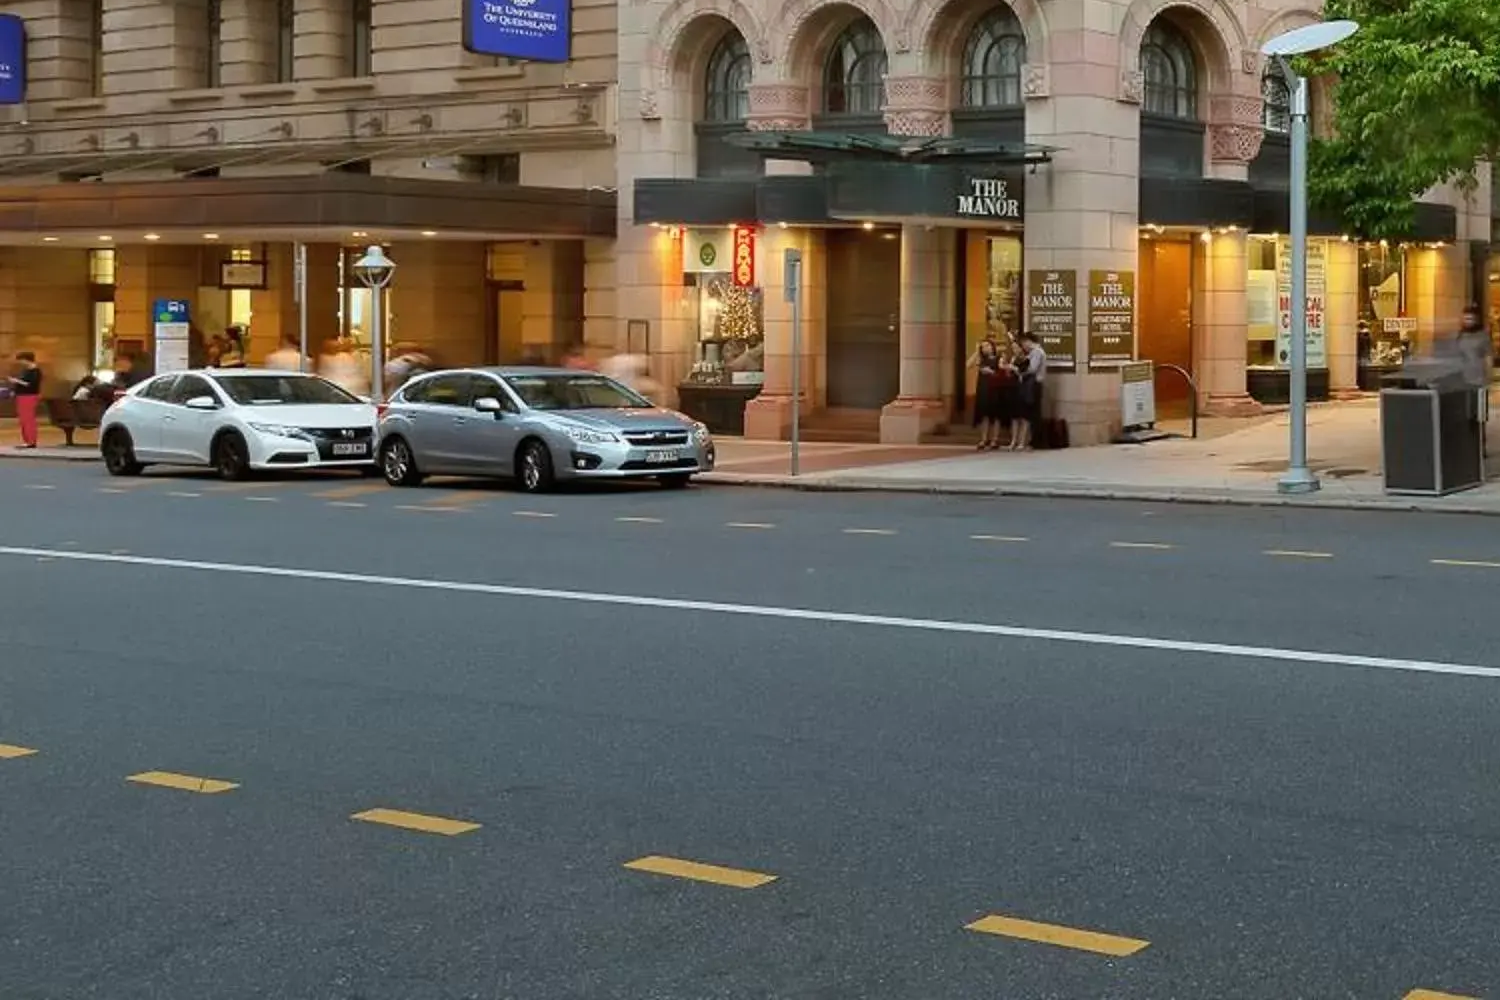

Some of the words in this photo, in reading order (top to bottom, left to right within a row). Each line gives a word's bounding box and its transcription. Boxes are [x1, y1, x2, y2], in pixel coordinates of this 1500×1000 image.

[483, 1, 503, 14] THE
[505, 5, 557, 21] UNIVERSITY
[500, 15, 557, 31] QUEENSLAND
[971, 178, 1007, 199] THE
[957, 195, 1020, 217] MANOR
[1042, 283, 1065, 295] THE
[1100, 283, 1124, 295] THE
[1032, 296, 1073, 308] MANOR
[1092, 296, 1131, 308] MANOR
[1280, 297, 1324, 311] MCAL
